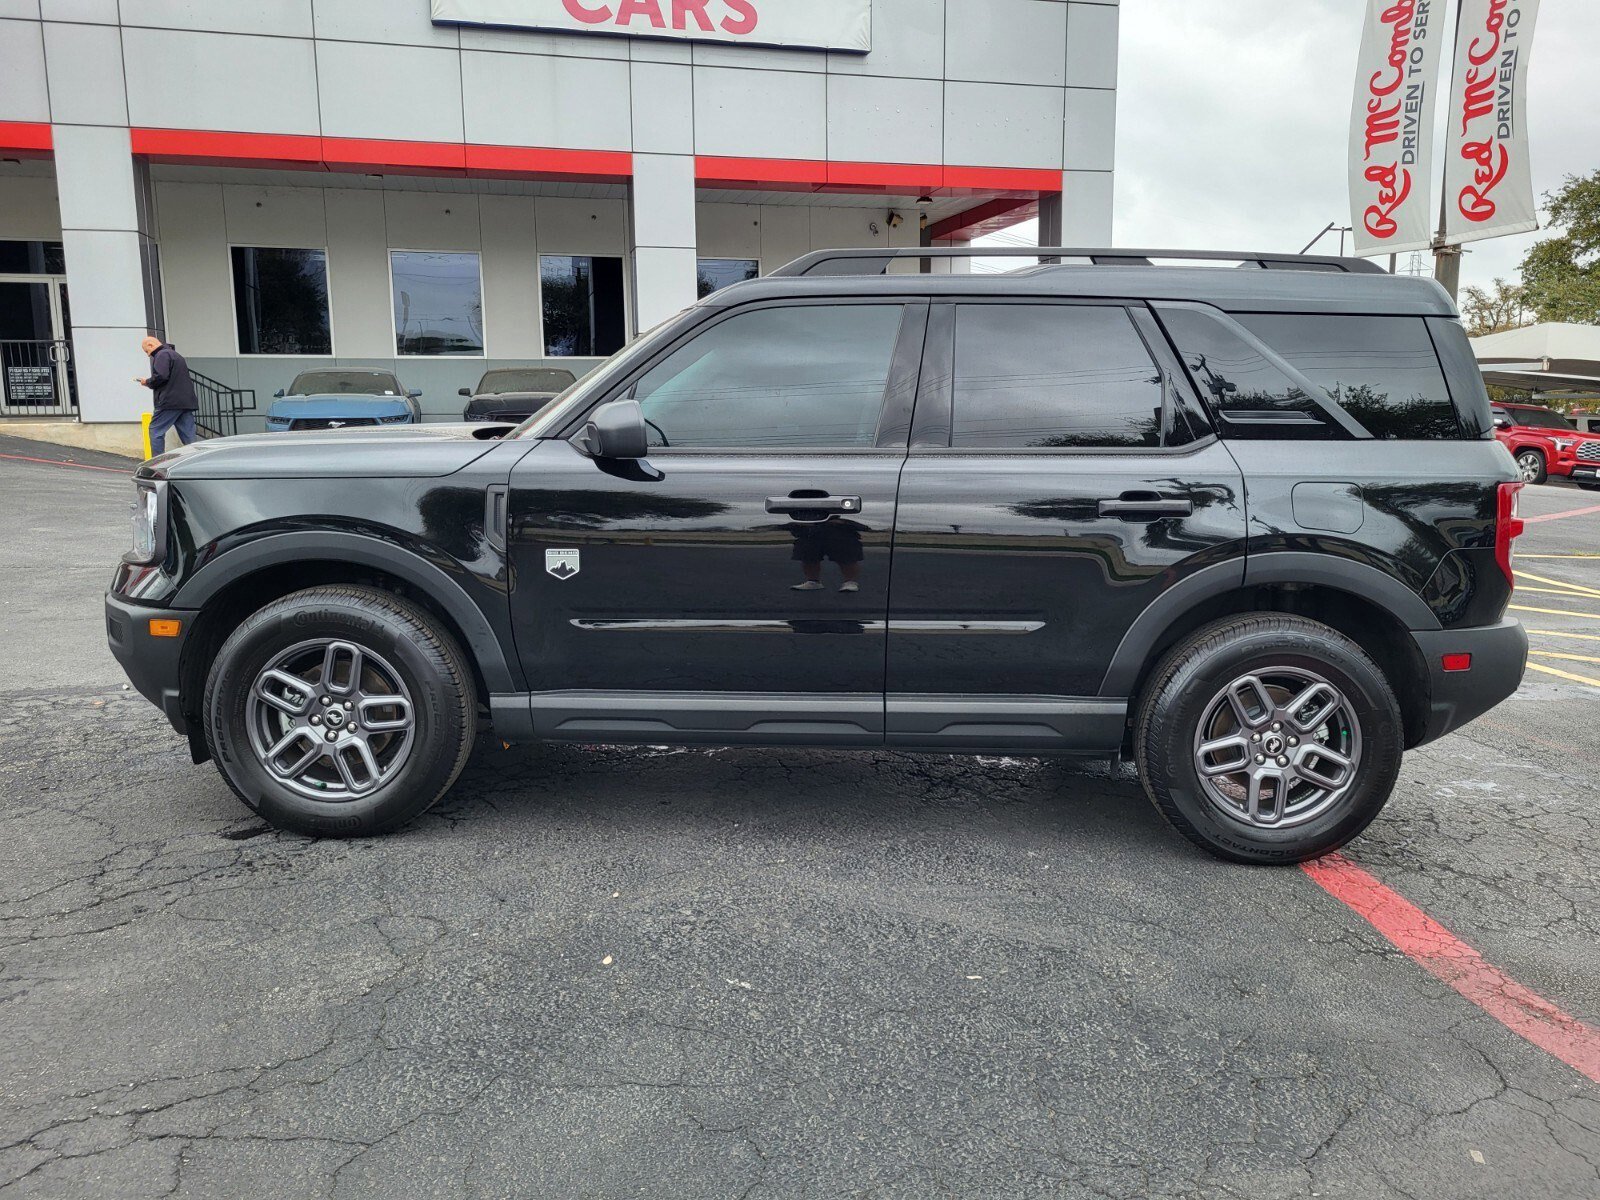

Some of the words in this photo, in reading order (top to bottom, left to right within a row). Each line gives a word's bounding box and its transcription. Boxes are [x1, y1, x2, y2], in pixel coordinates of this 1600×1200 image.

[1413, 0, 1430, 40] SER
[1503, 9, 1521, 44] TO
[1408, 46, 1424, 77] TO
[1497, 50, 1516, 140] DRIVEN
[1401, 84, 1420, 165] DRIVEN
[1363, 161, 1412, 239] Red
[1458, 135, 1509, 222] Red
[214, 666, 234, 764] PROCONTAC
